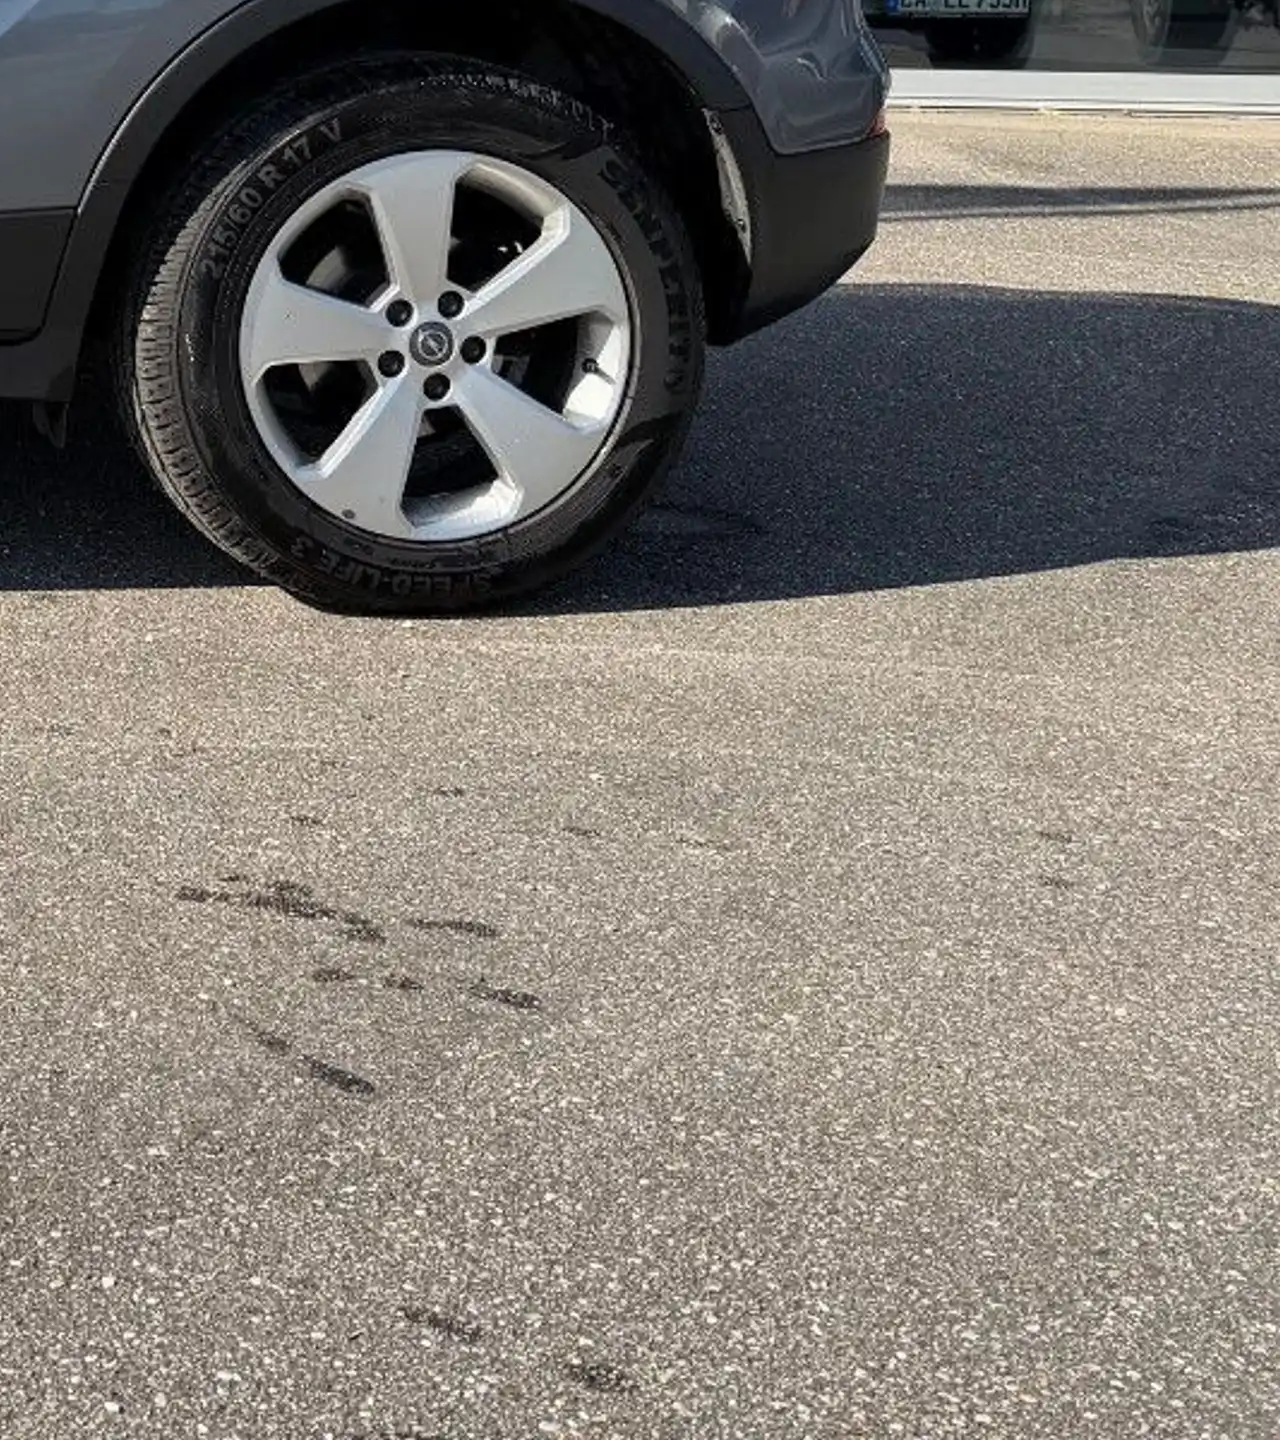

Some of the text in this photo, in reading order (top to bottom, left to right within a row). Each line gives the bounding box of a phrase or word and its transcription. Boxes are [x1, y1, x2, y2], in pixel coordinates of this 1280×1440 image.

[256, 163, 288, 189] R
[281, 136, 313, 167] 17
[320, 117, 342, 142] V
